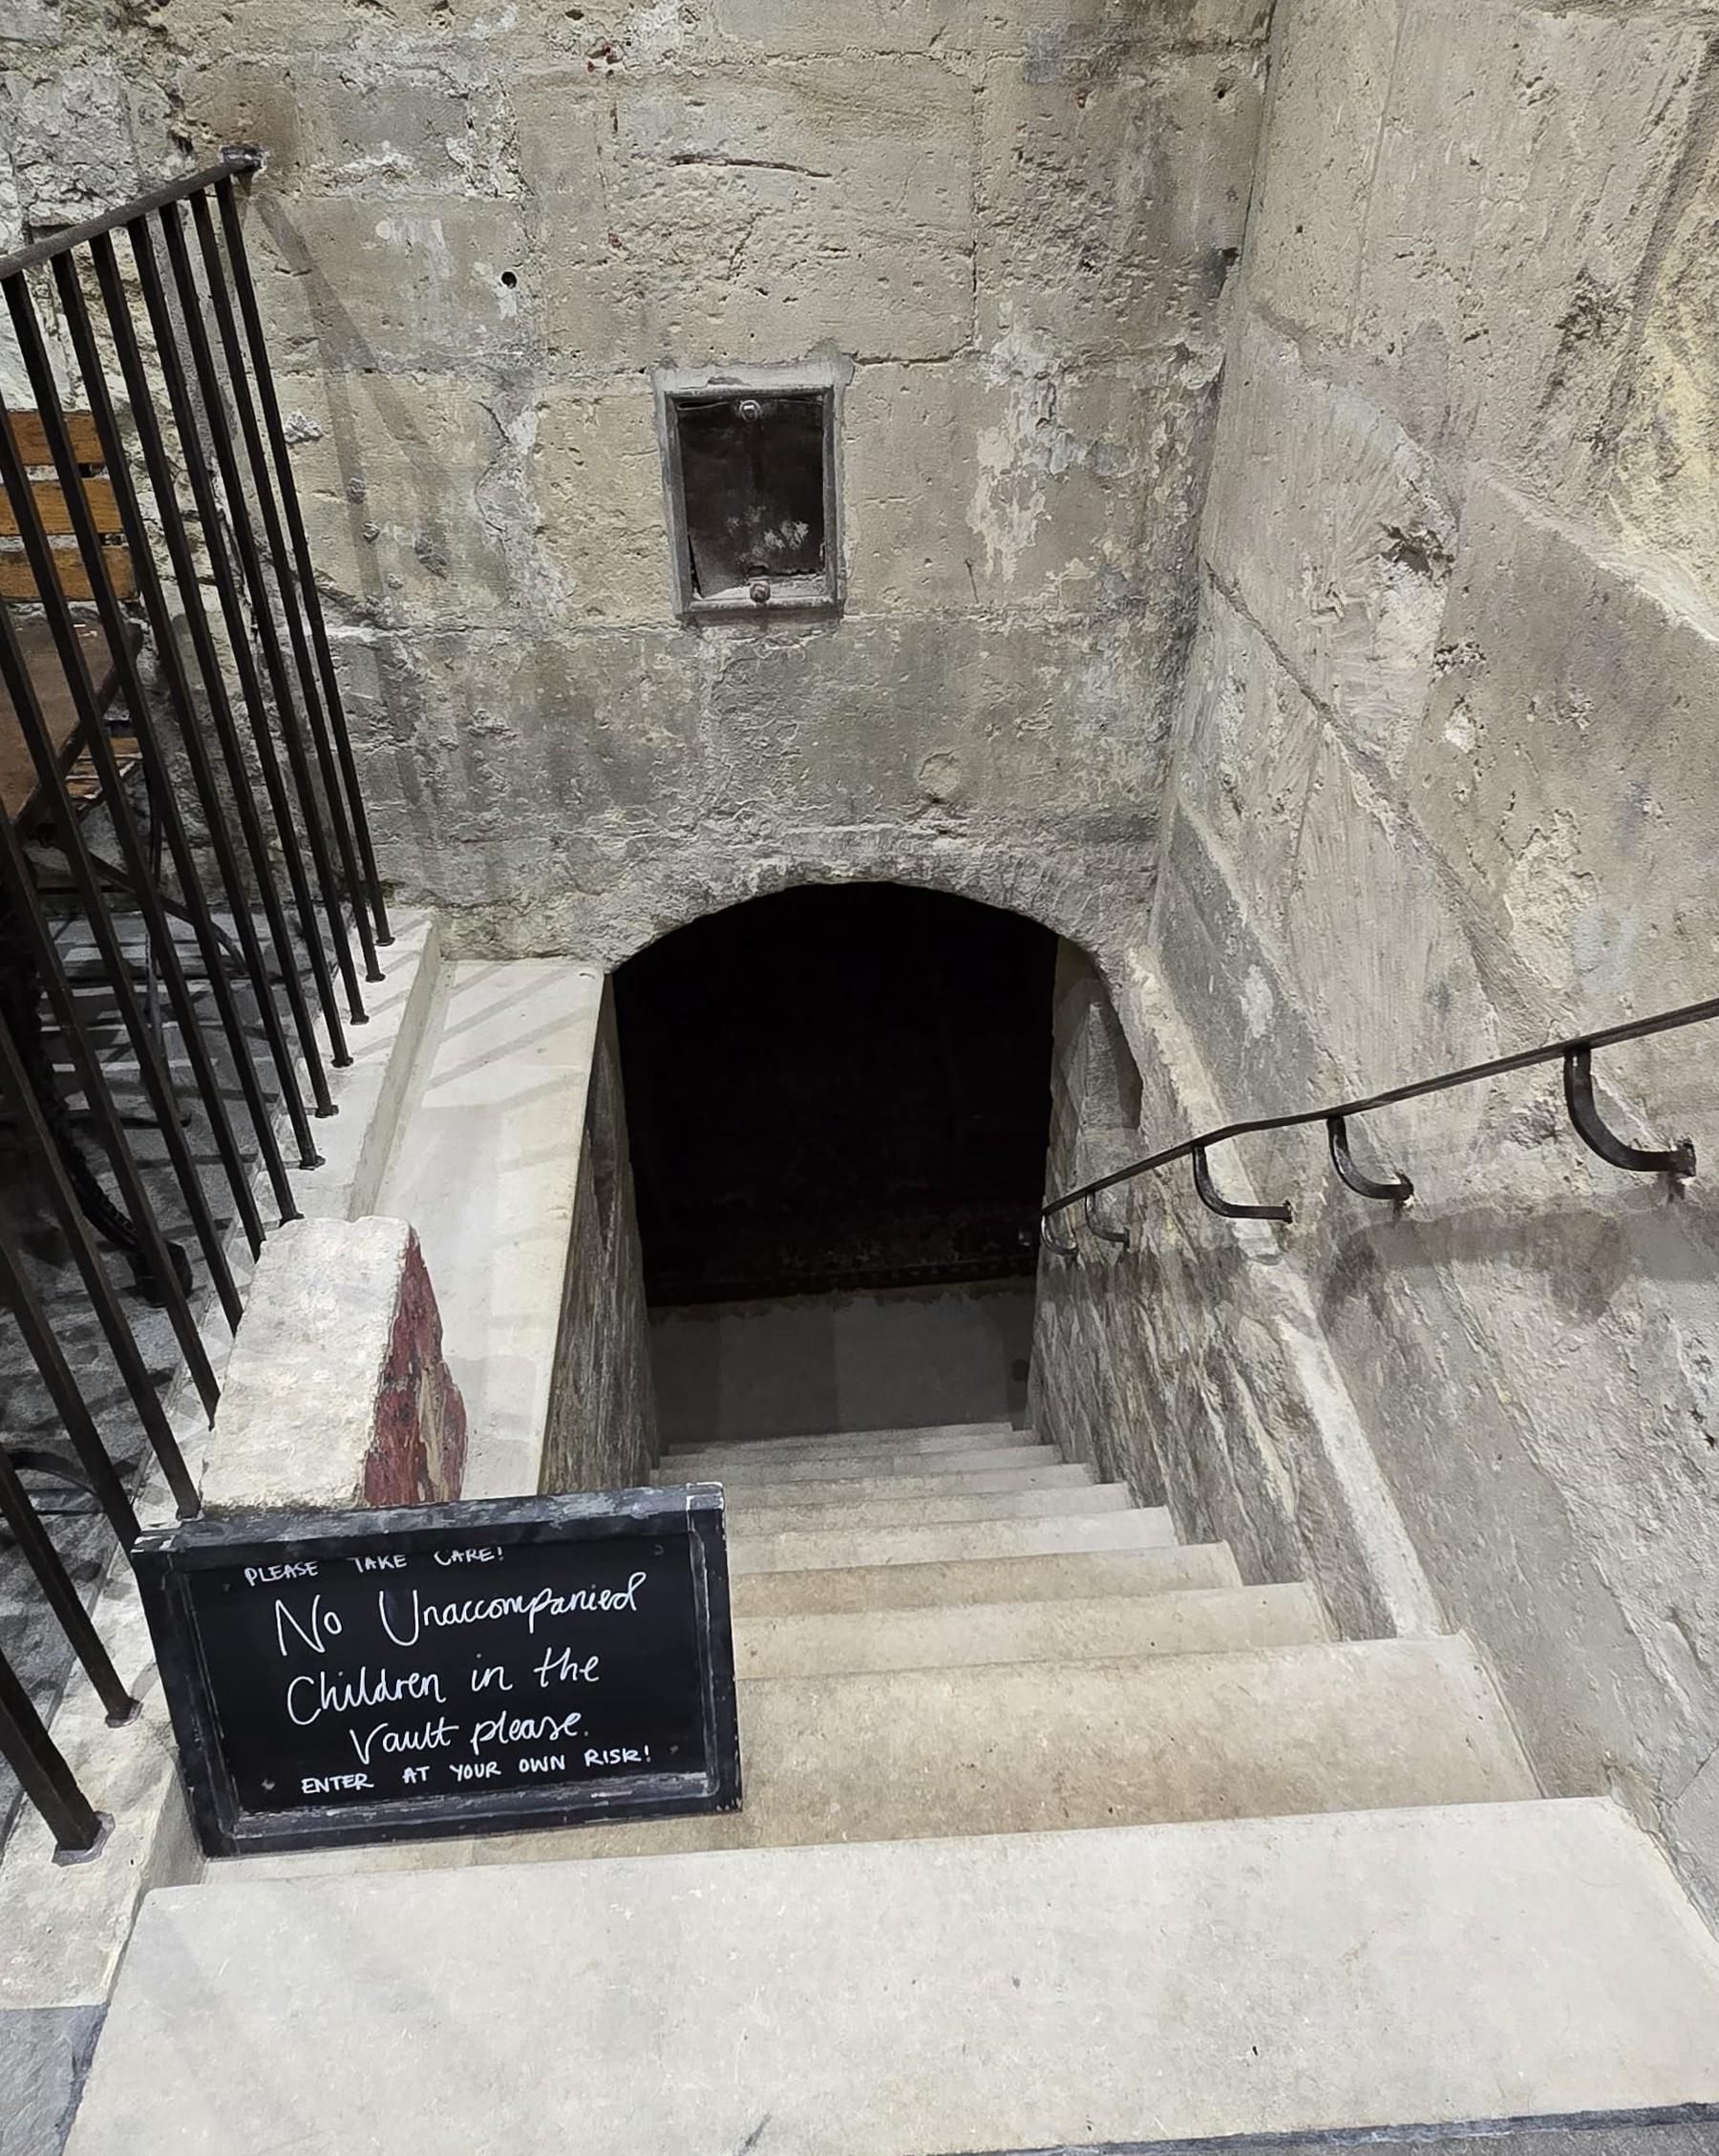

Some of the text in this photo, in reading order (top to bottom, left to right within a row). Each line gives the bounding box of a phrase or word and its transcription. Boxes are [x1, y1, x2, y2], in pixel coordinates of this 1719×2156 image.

[244, 1546, 502, 1587] PLEASE TAKE CARE!
[275, 1571, 647, 1657] No Unaccompanied
[286, 1646, 600, 1725] Children in the
[349, 1716, 459, 1765] Vault
[301, 1744, 651, 1794] ENTER AT YOUR OWN RISK!
